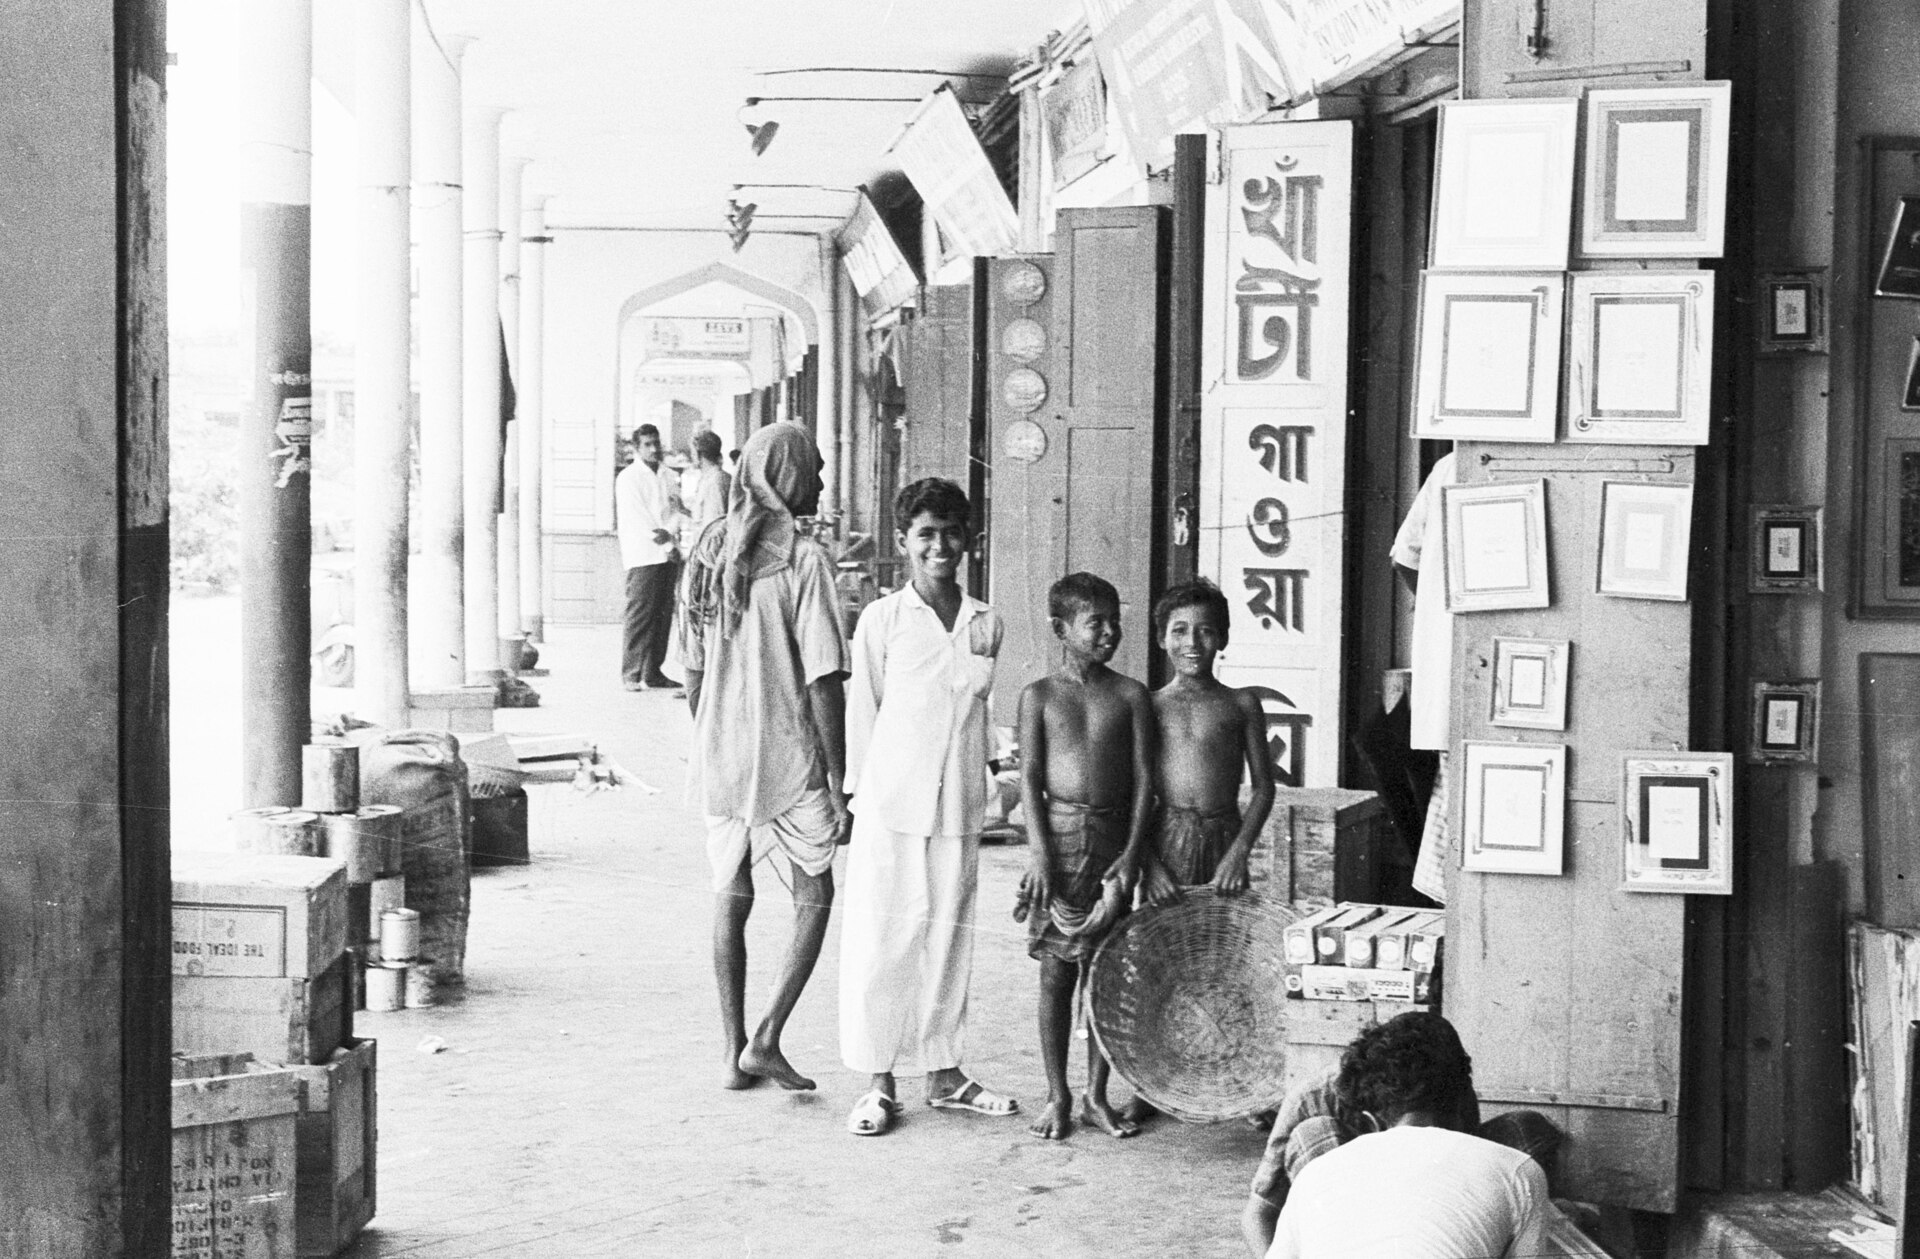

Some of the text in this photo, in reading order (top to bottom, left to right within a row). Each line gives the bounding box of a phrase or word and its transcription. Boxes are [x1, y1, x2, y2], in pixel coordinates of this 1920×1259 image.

[173, 941, 265, 958] THE IDEAL FOOD
